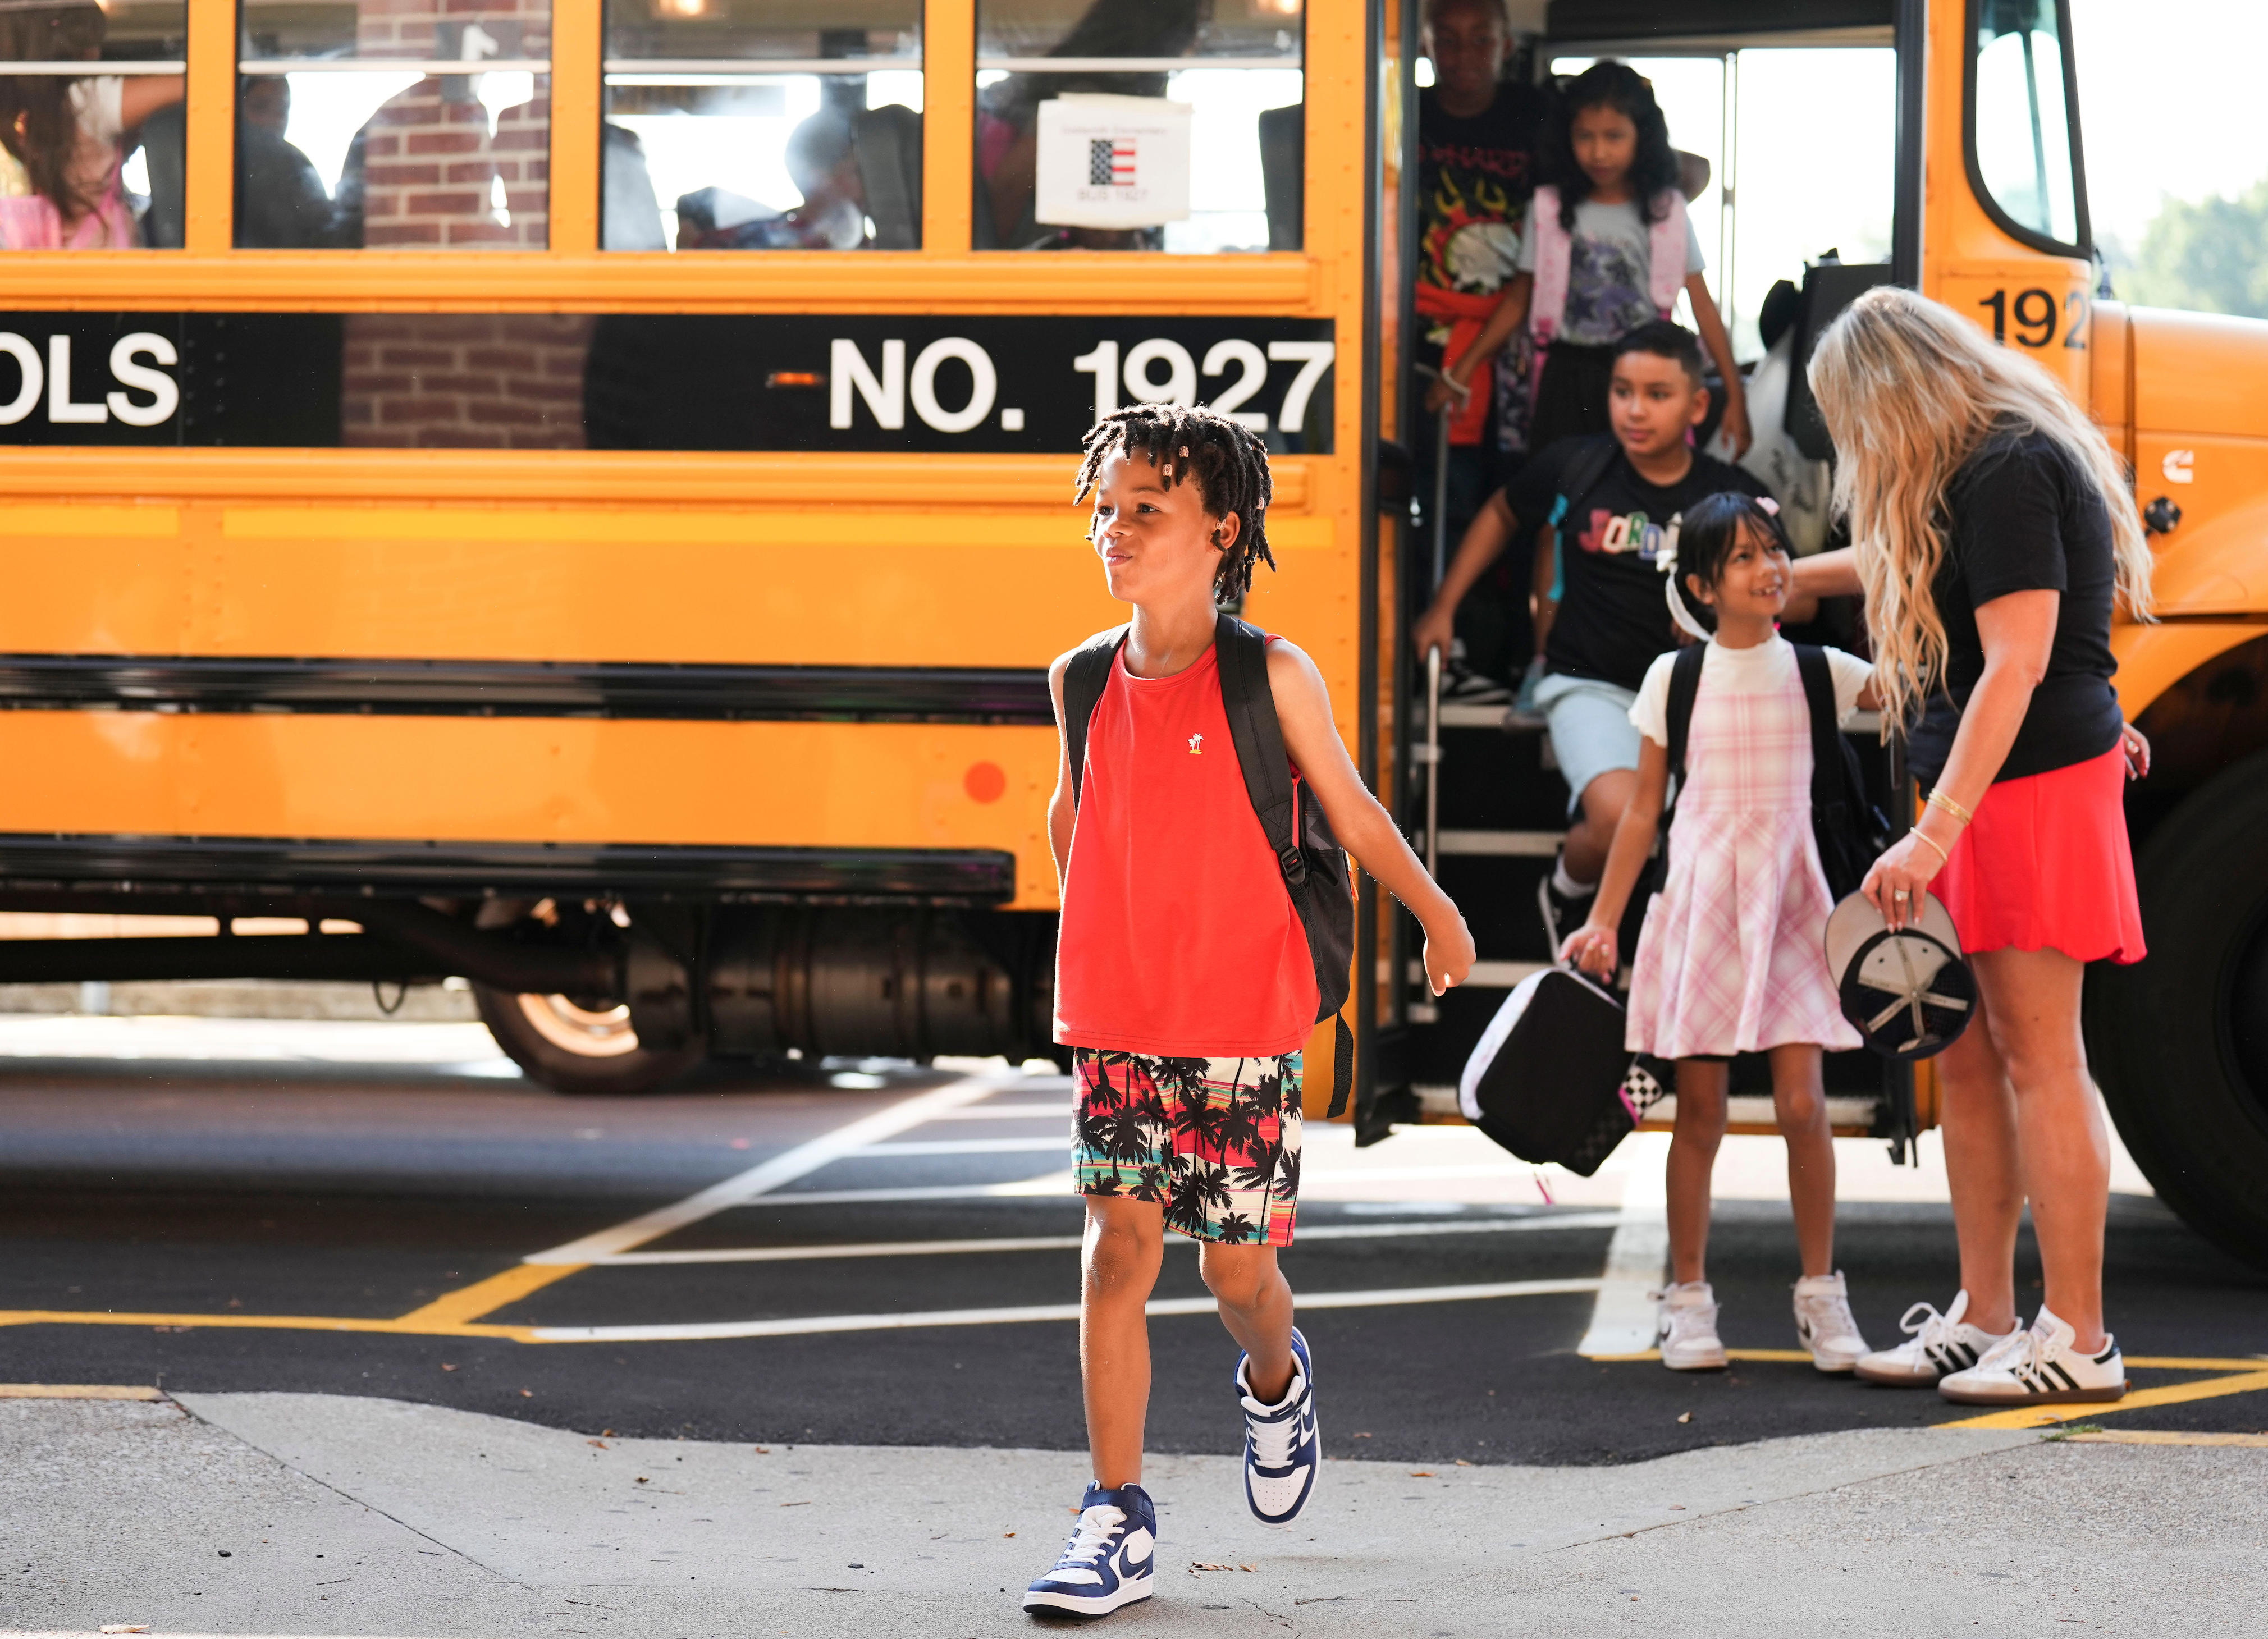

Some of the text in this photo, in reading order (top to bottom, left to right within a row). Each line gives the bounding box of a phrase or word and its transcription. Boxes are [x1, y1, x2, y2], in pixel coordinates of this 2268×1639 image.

[1979, 288, 2086, 349] 192
[830, 337, 1336, 433] NO. 1927
